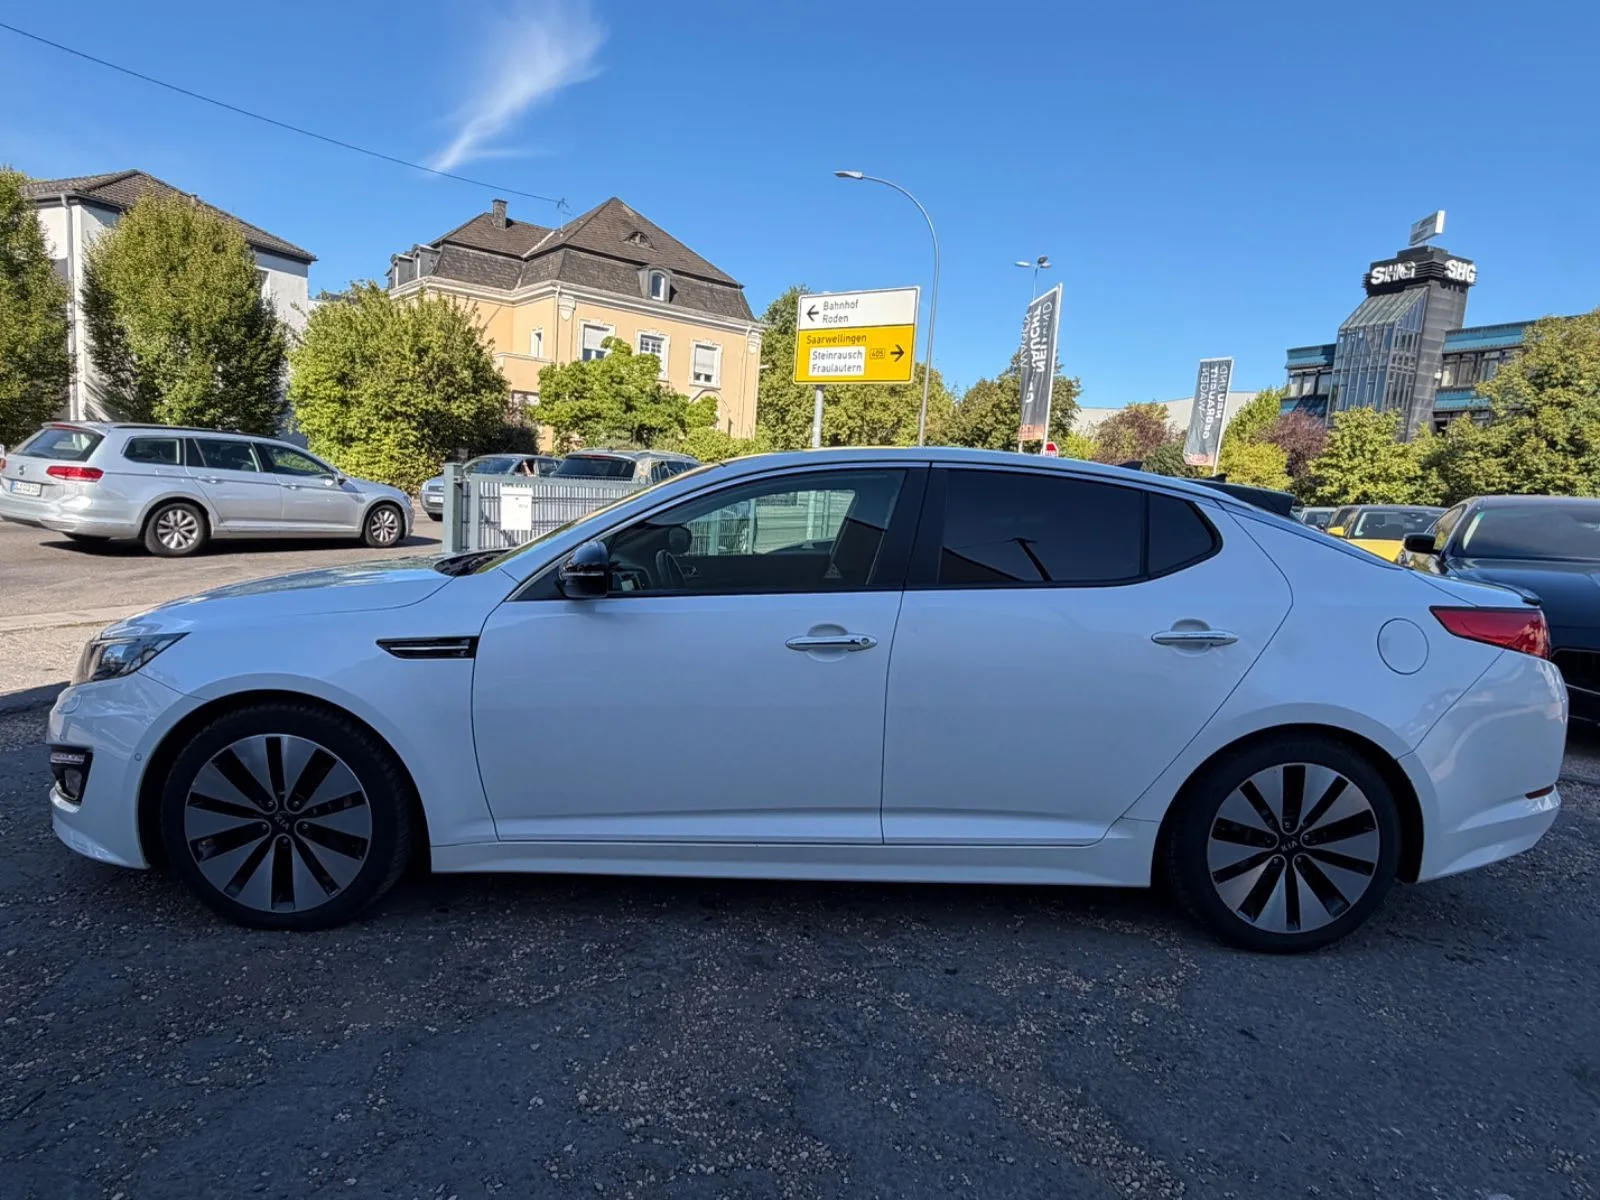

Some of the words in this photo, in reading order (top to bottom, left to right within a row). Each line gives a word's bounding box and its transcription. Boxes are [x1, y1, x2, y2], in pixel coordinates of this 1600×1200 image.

[1445, 259, 1477, 283] SHG
[823, 299, 859, 311] Bahnhof
[822, 314, 849, 323] Roden
[806, 334, 867, 346] Saarwellingen
[812, 350, 863, 360] Steinrausch
[871, 350, 884, 358] 405
[812, 364, 862, 373] Fraulautern
